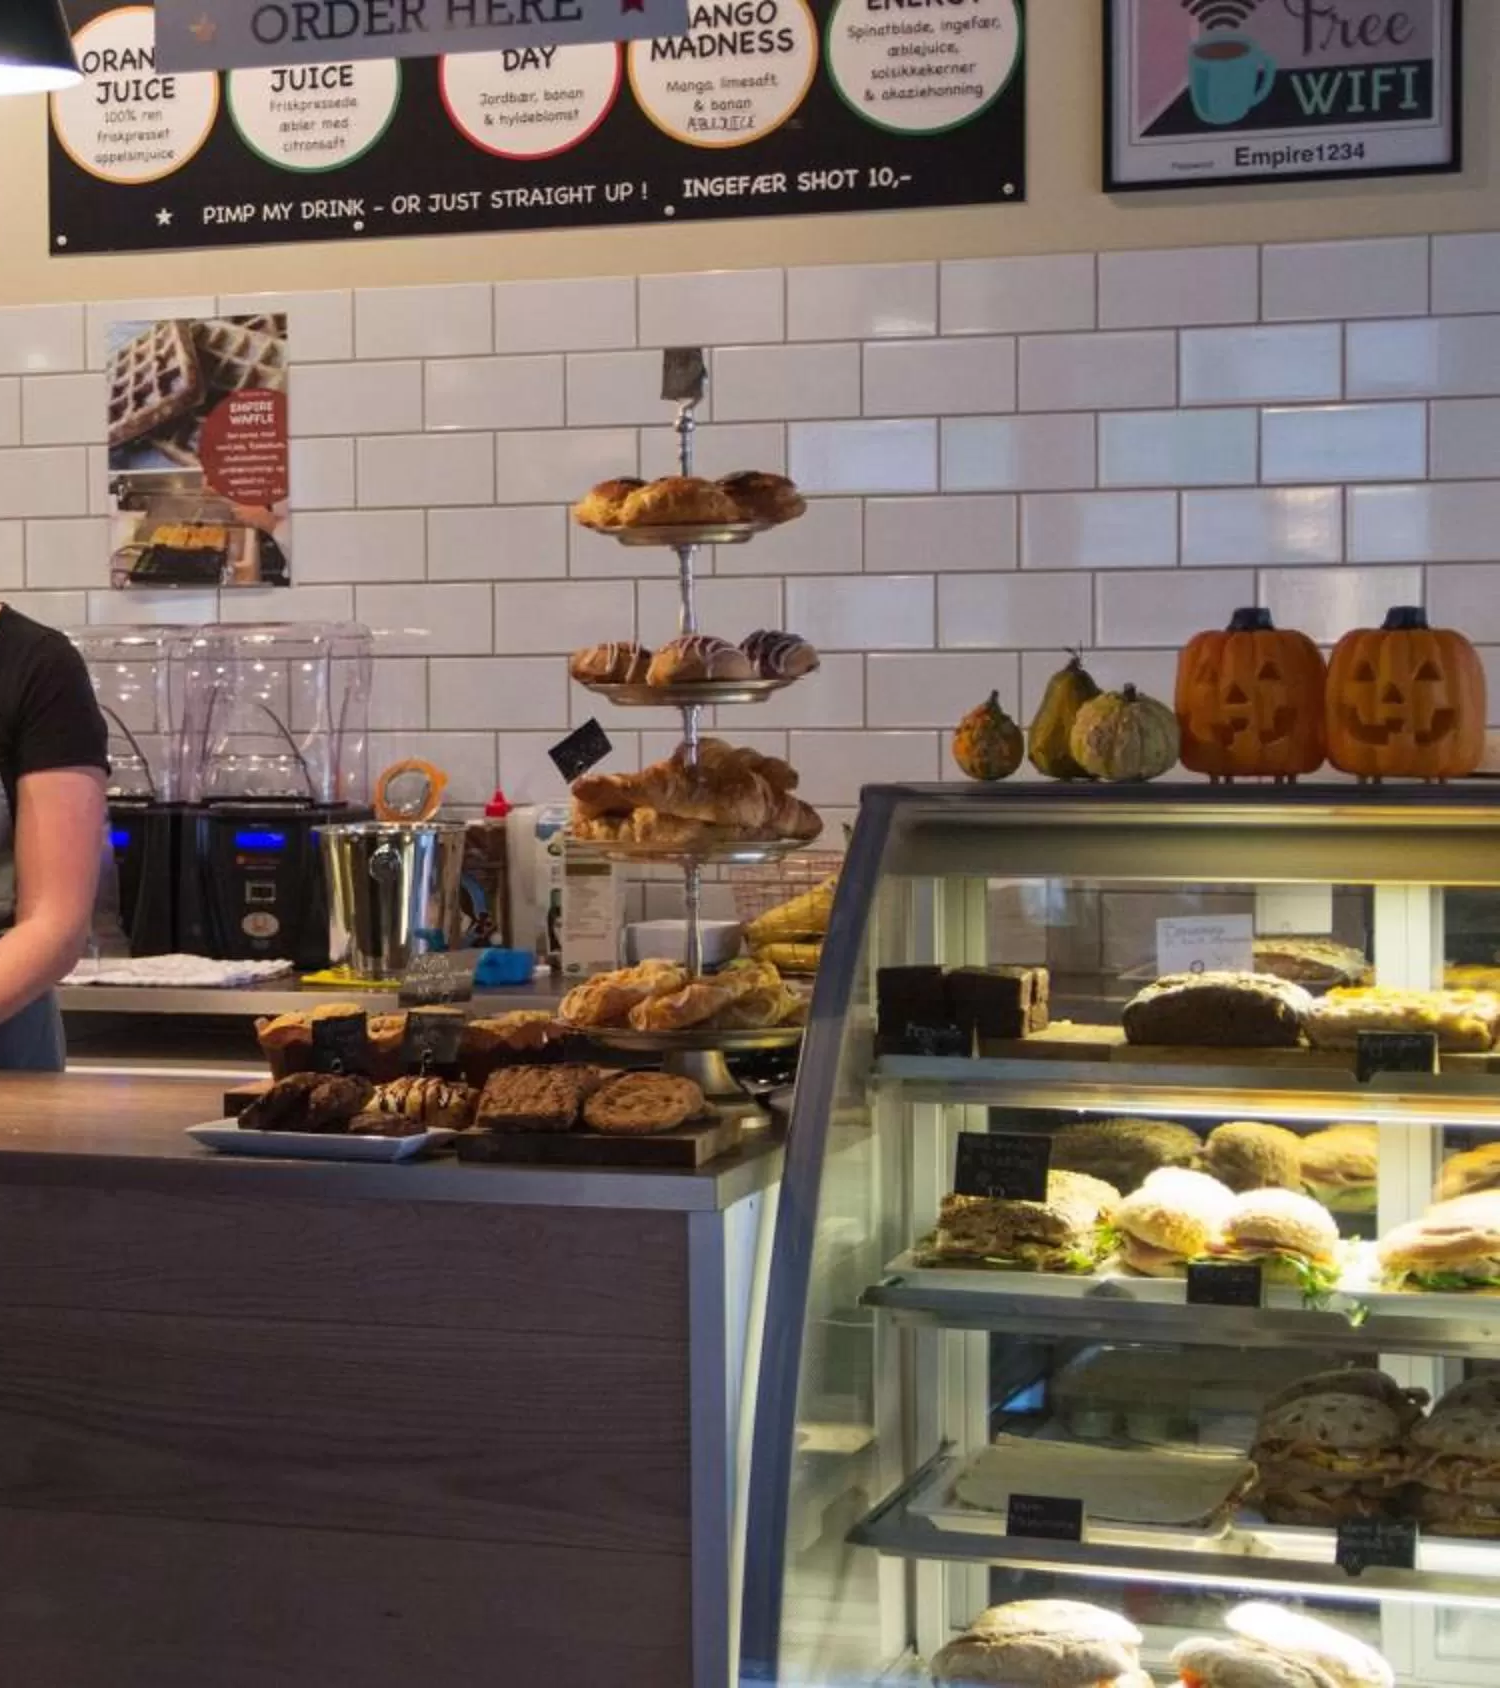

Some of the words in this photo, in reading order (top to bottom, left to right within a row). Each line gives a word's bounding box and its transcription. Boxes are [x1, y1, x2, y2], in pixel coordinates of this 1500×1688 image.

[251, 0, 429, 45] ORDER
[444, 0, 583, 30] HERE
[688, 0, 777, 30] ANGO
[651, 28, 794, 61] MADNESS
[82, 47, 155, 74] ORAN
[501, 44, 557, 72] DAY
[271, 64, 353, 92] JUICE
[871, 62, 977, 80] solsikkekerner
[720, 72, 778, 89] limesaft
[96, 77, 175, 104] JUICE
[544, 89, 584, 101] banan
[864, 89, 875, 101] &
[1289, 65, 1421, 116] WIFI
[694, 99, 703, 112] &
[711, 97, 752, 111] banan
[105, 110, 137, 124] 100%
[321, 118, 349, 129] med
[484, 113, 493, 125] &
[499, 109, 580, 127] hyldeblomst
[97, 128, 170, 144] friskpresset
[283, 136, 344, 152] citronsaft
[95, 149, 174, 166] appelsinjuice
[1234, 141, 1365, 170] Empire1234
[203, 204, 255, 225] PIMP
[262, 203, 294, 222] MY
[301, 199, 365, 220] DRINK
[391, 194, 421, 215] OR
[427, 191, 482, 213] JUST
[490, 184, 596, 210] STRAIGHT
[604, 183, 634, 202] UP
[683, 172, 787, 200] INGEFÆR
[797, 169, 859, 192] SHOT
